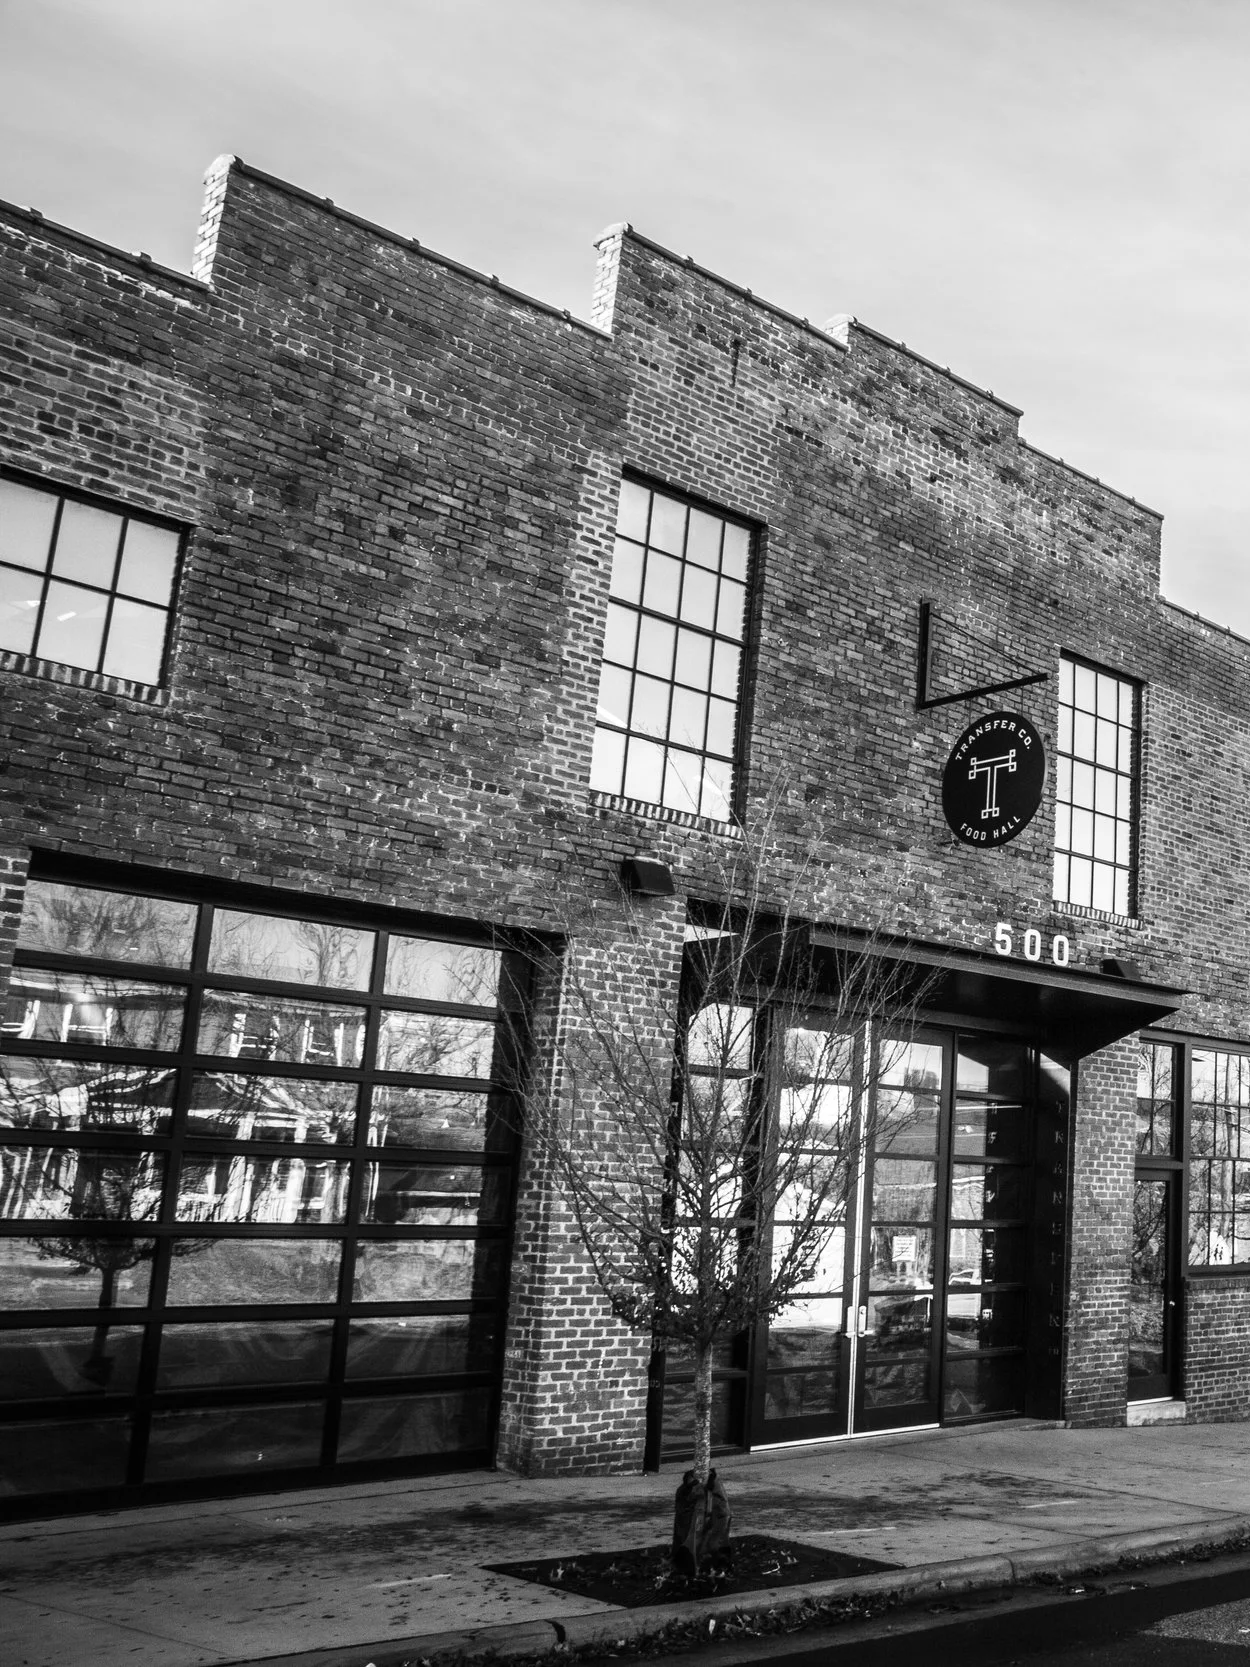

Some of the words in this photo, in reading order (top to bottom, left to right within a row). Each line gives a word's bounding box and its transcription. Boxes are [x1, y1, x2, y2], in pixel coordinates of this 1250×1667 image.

[955, 719, 1016, 761] TRANSFER
[1018, 728, 1032, 750] CO.
[960, 822, 987, 841] FOOD
[993, 815, 1021, 839] HALL
[995, 922, 1070, 967] 500
